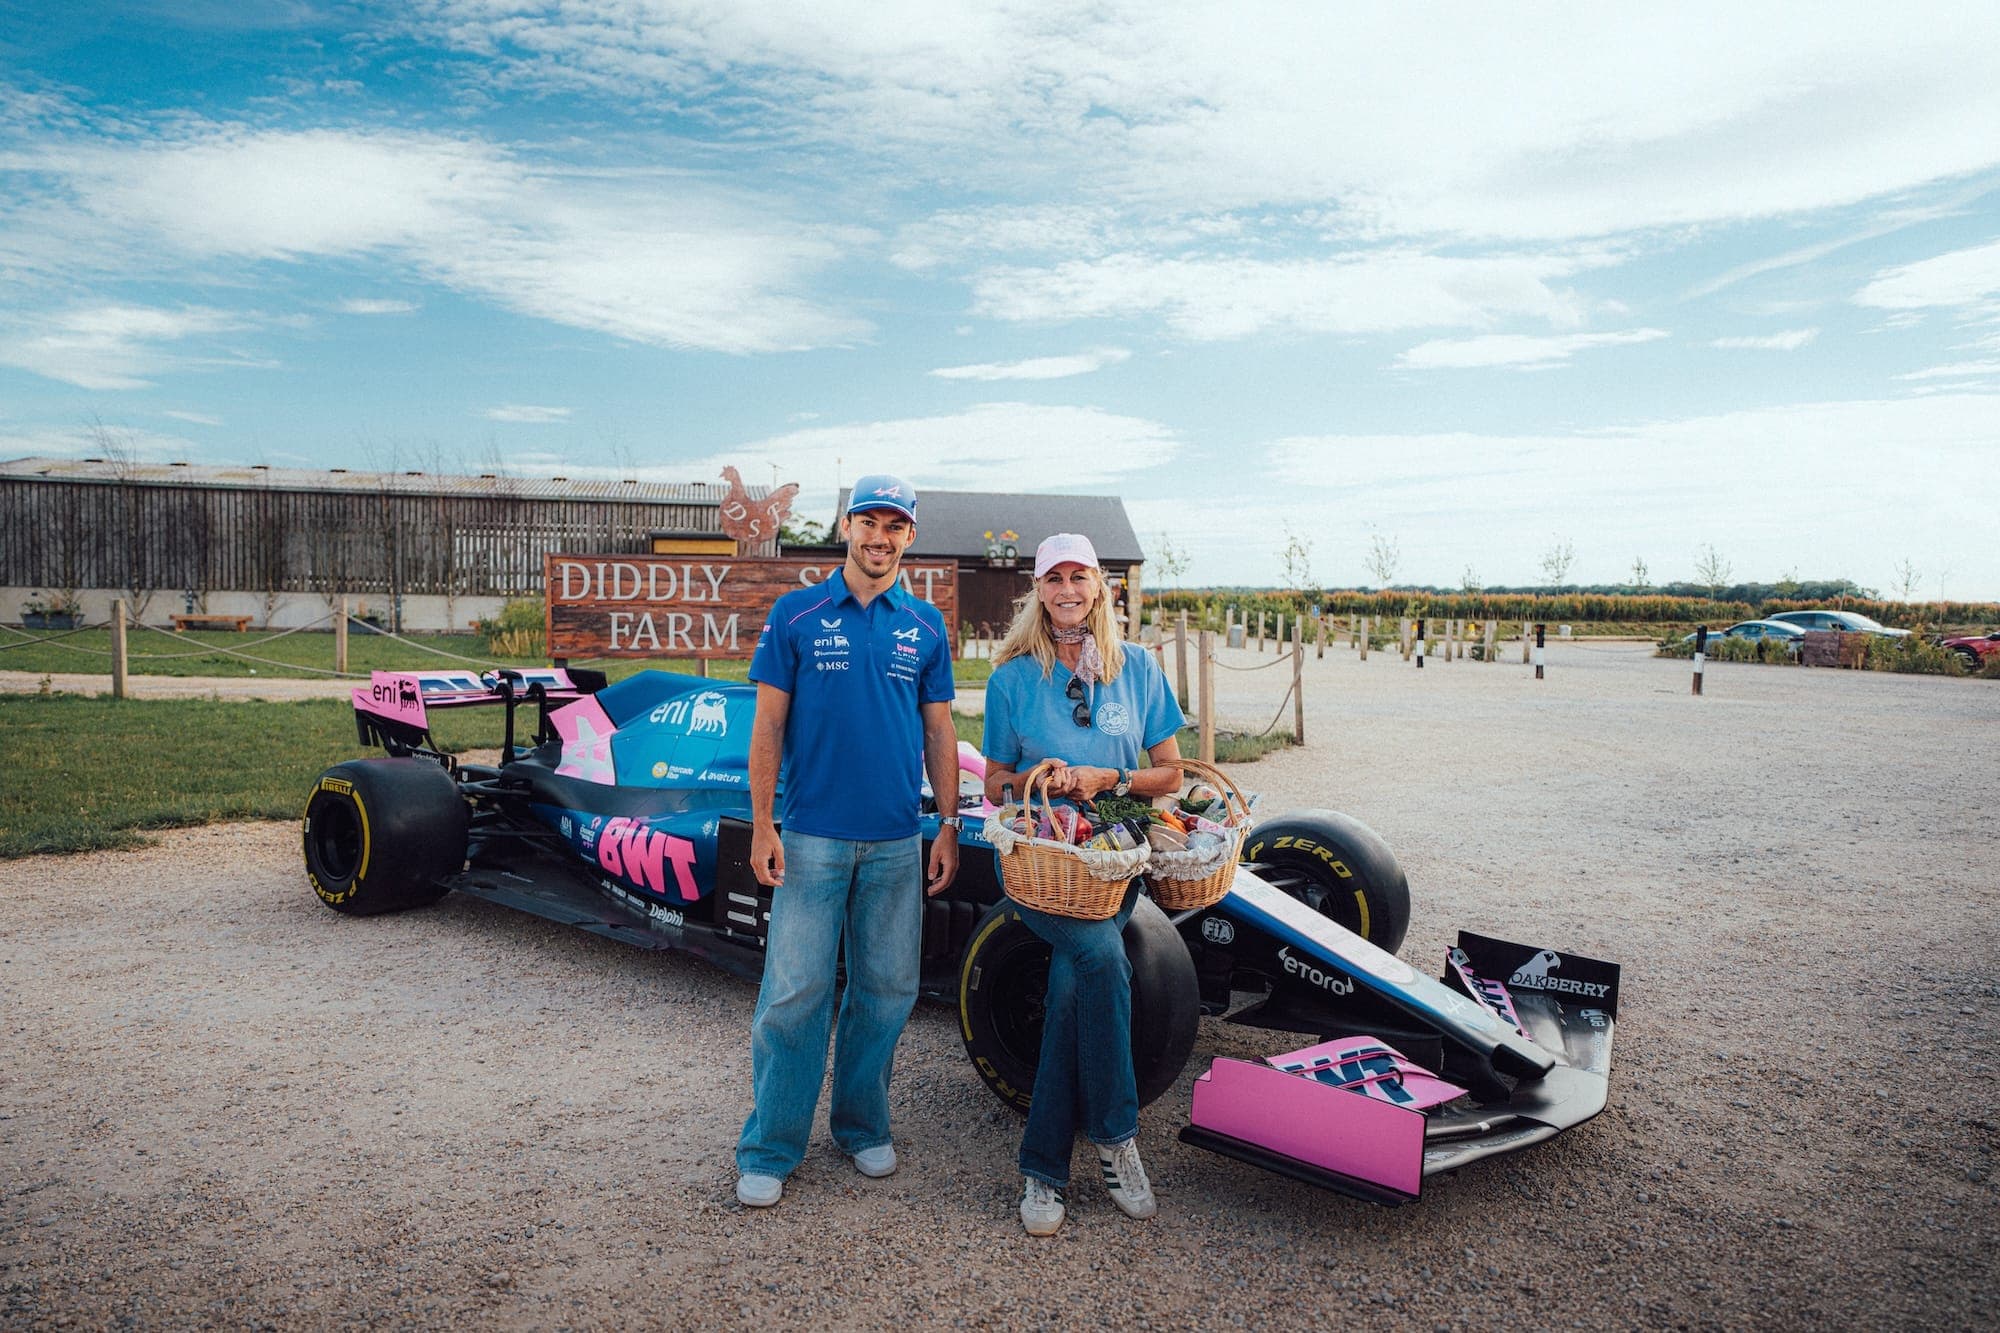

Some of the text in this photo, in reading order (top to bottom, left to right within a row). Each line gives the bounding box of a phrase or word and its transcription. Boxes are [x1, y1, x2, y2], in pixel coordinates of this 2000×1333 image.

[559, 562, 732, 602] DIDDLY
[607, 611, 741, 651] FARM
[814, 636, 833, 647] eni
[825, 661, 849, 671] MSC
[373, 681, 397, 704] eni
[650, 694, 697, 724] eni
[321, 776, 352, 796] PIRELLI
[707, 772, 741, 783] avature
[598, 816, 701, 902] BWT
[1250, 836, 1353, 878] P ZERO
[649, 902, 684, 927] Delphi
[1510, 971, 1611, 998] OAKBERRY
